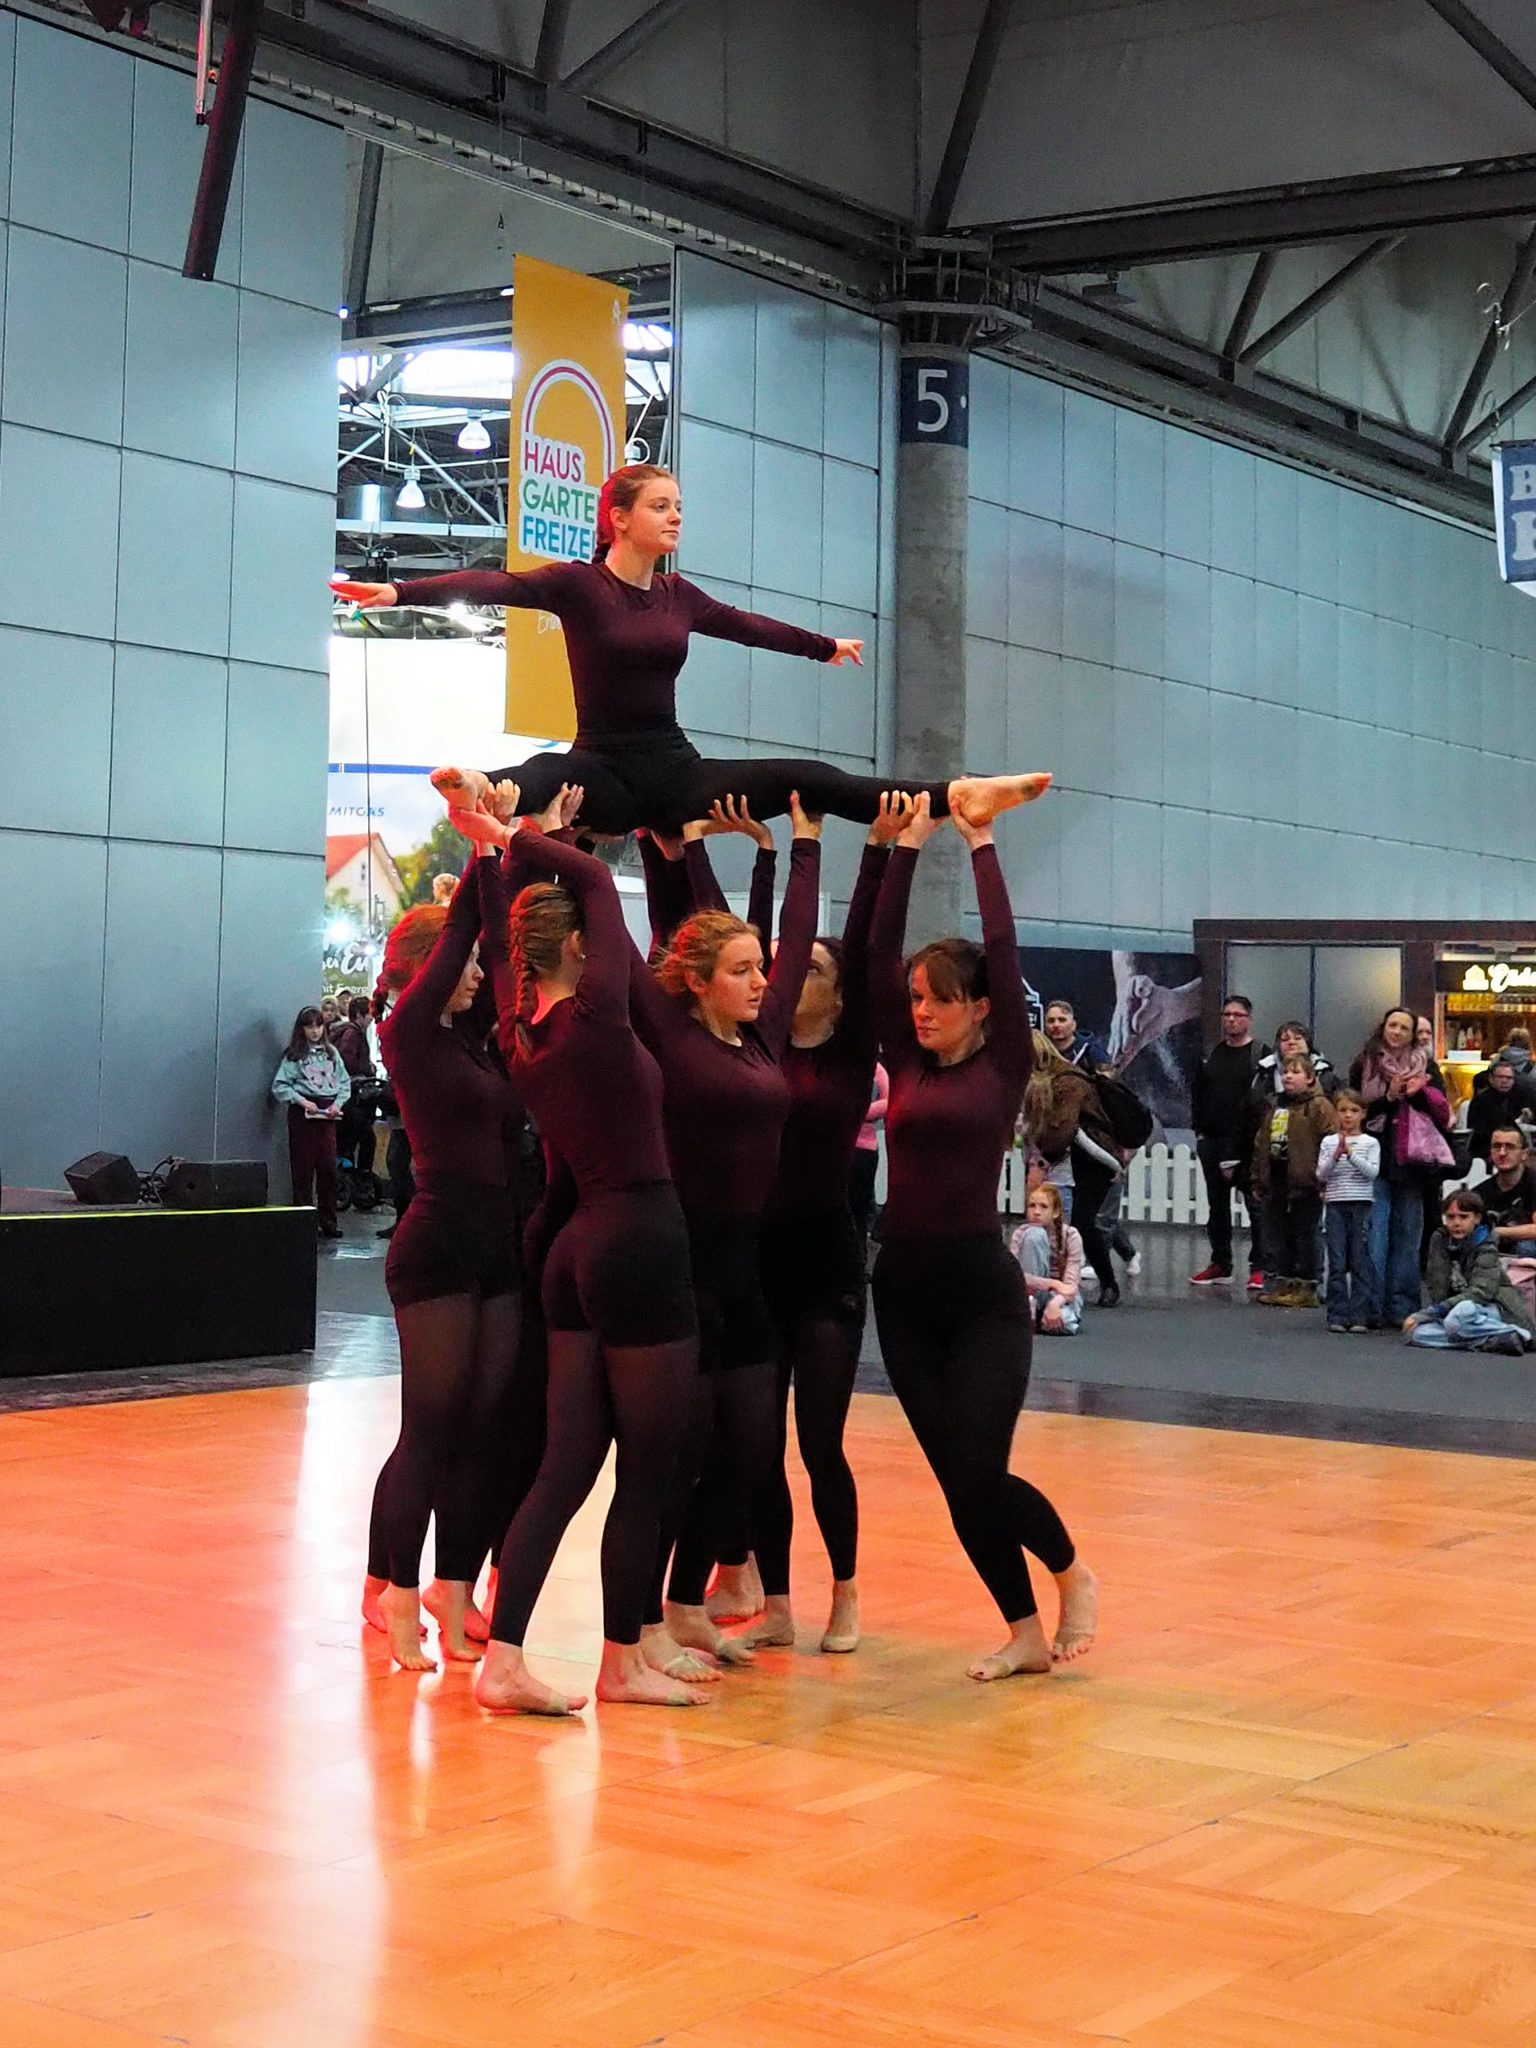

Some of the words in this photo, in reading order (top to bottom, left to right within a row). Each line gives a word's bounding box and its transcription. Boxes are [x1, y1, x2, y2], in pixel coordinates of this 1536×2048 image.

[917, 368, 949, 433] 5
[524, 439, 582, 483] HAUS
[523, 478, 600, 525] GARTE
